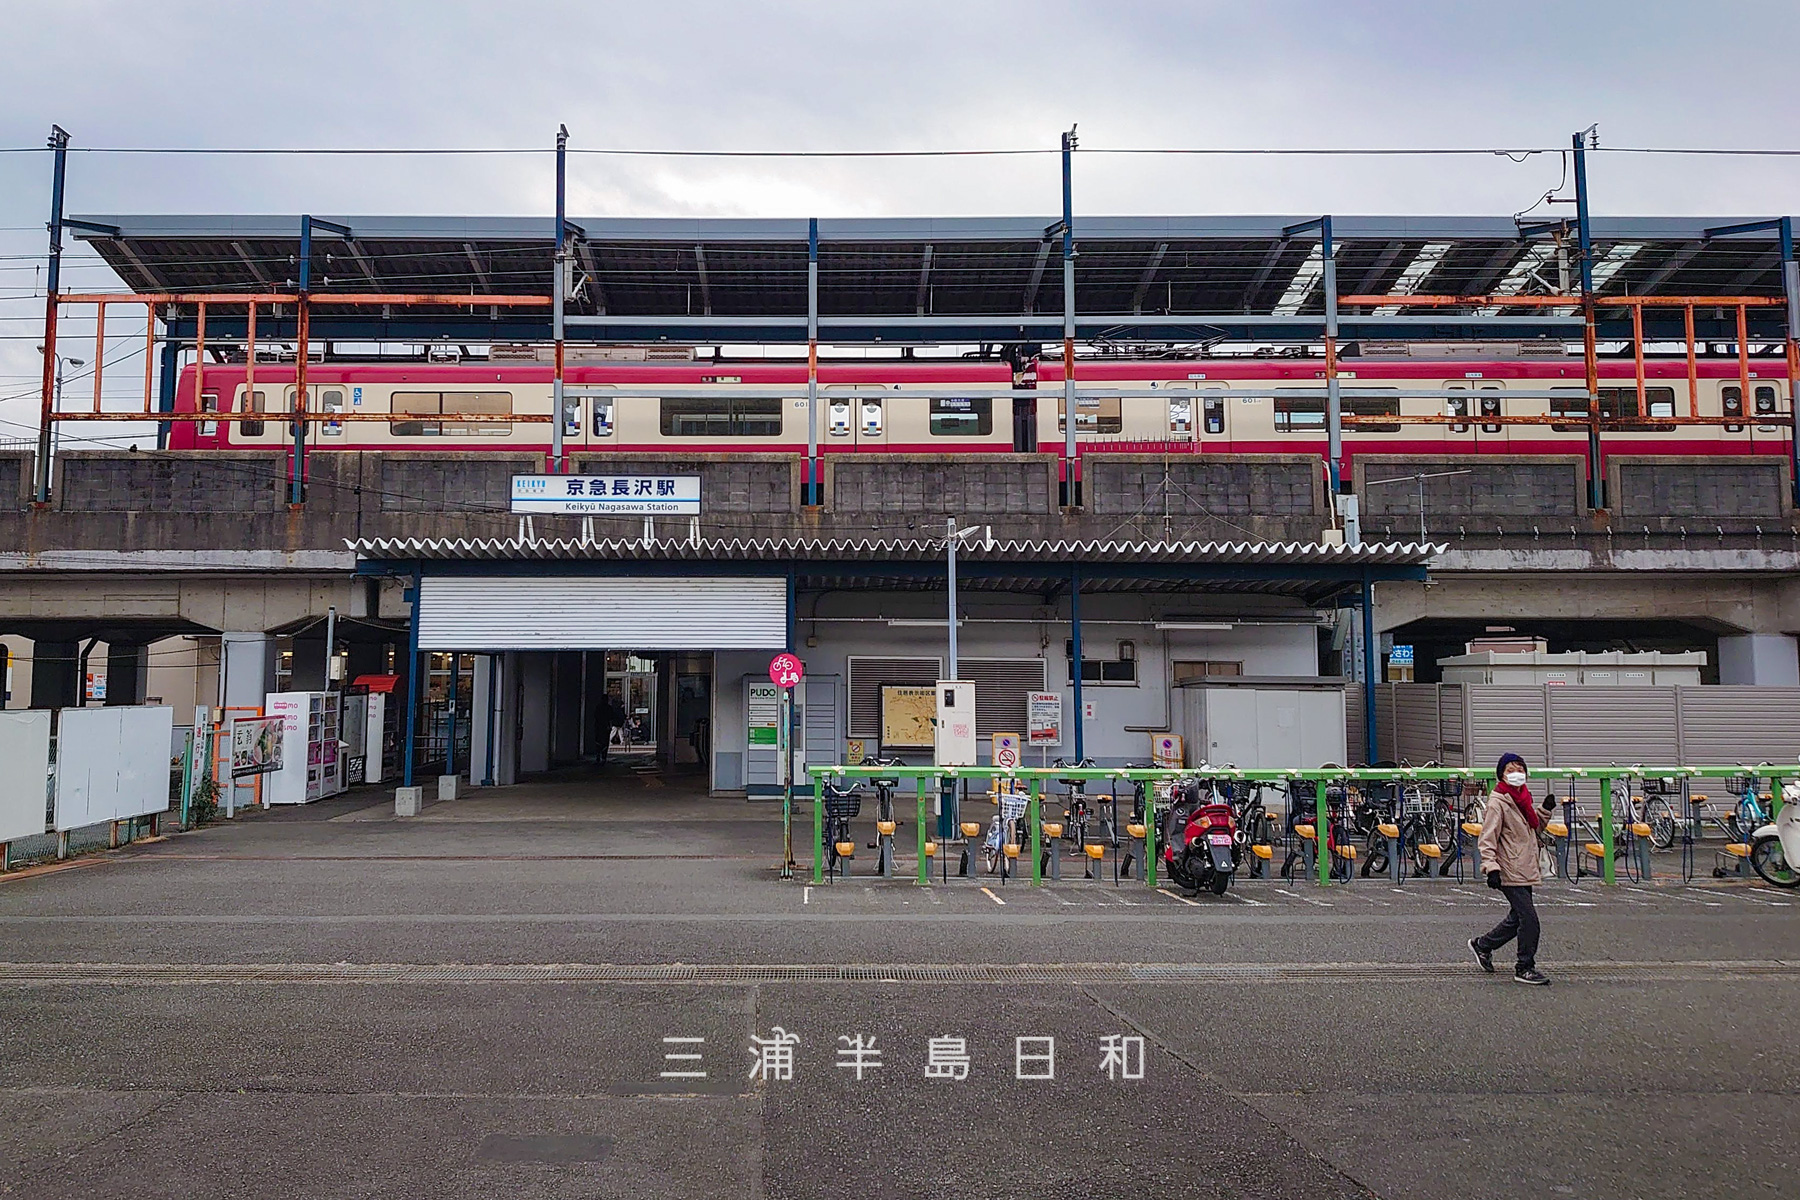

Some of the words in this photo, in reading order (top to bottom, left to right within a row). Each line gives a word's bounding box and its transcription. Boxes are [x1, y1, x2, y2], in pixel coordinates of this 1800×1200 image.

[516, 479, 546, 488] KEIKYU
[565, 478, 676, 497] 京急長沢駅
[565, 502, 596, 512] Keikyū
[598, 502, 644, 512] Nagasawa
[646, 502, 679, 511] Station
[750, 688, 777, 697] PUDO
